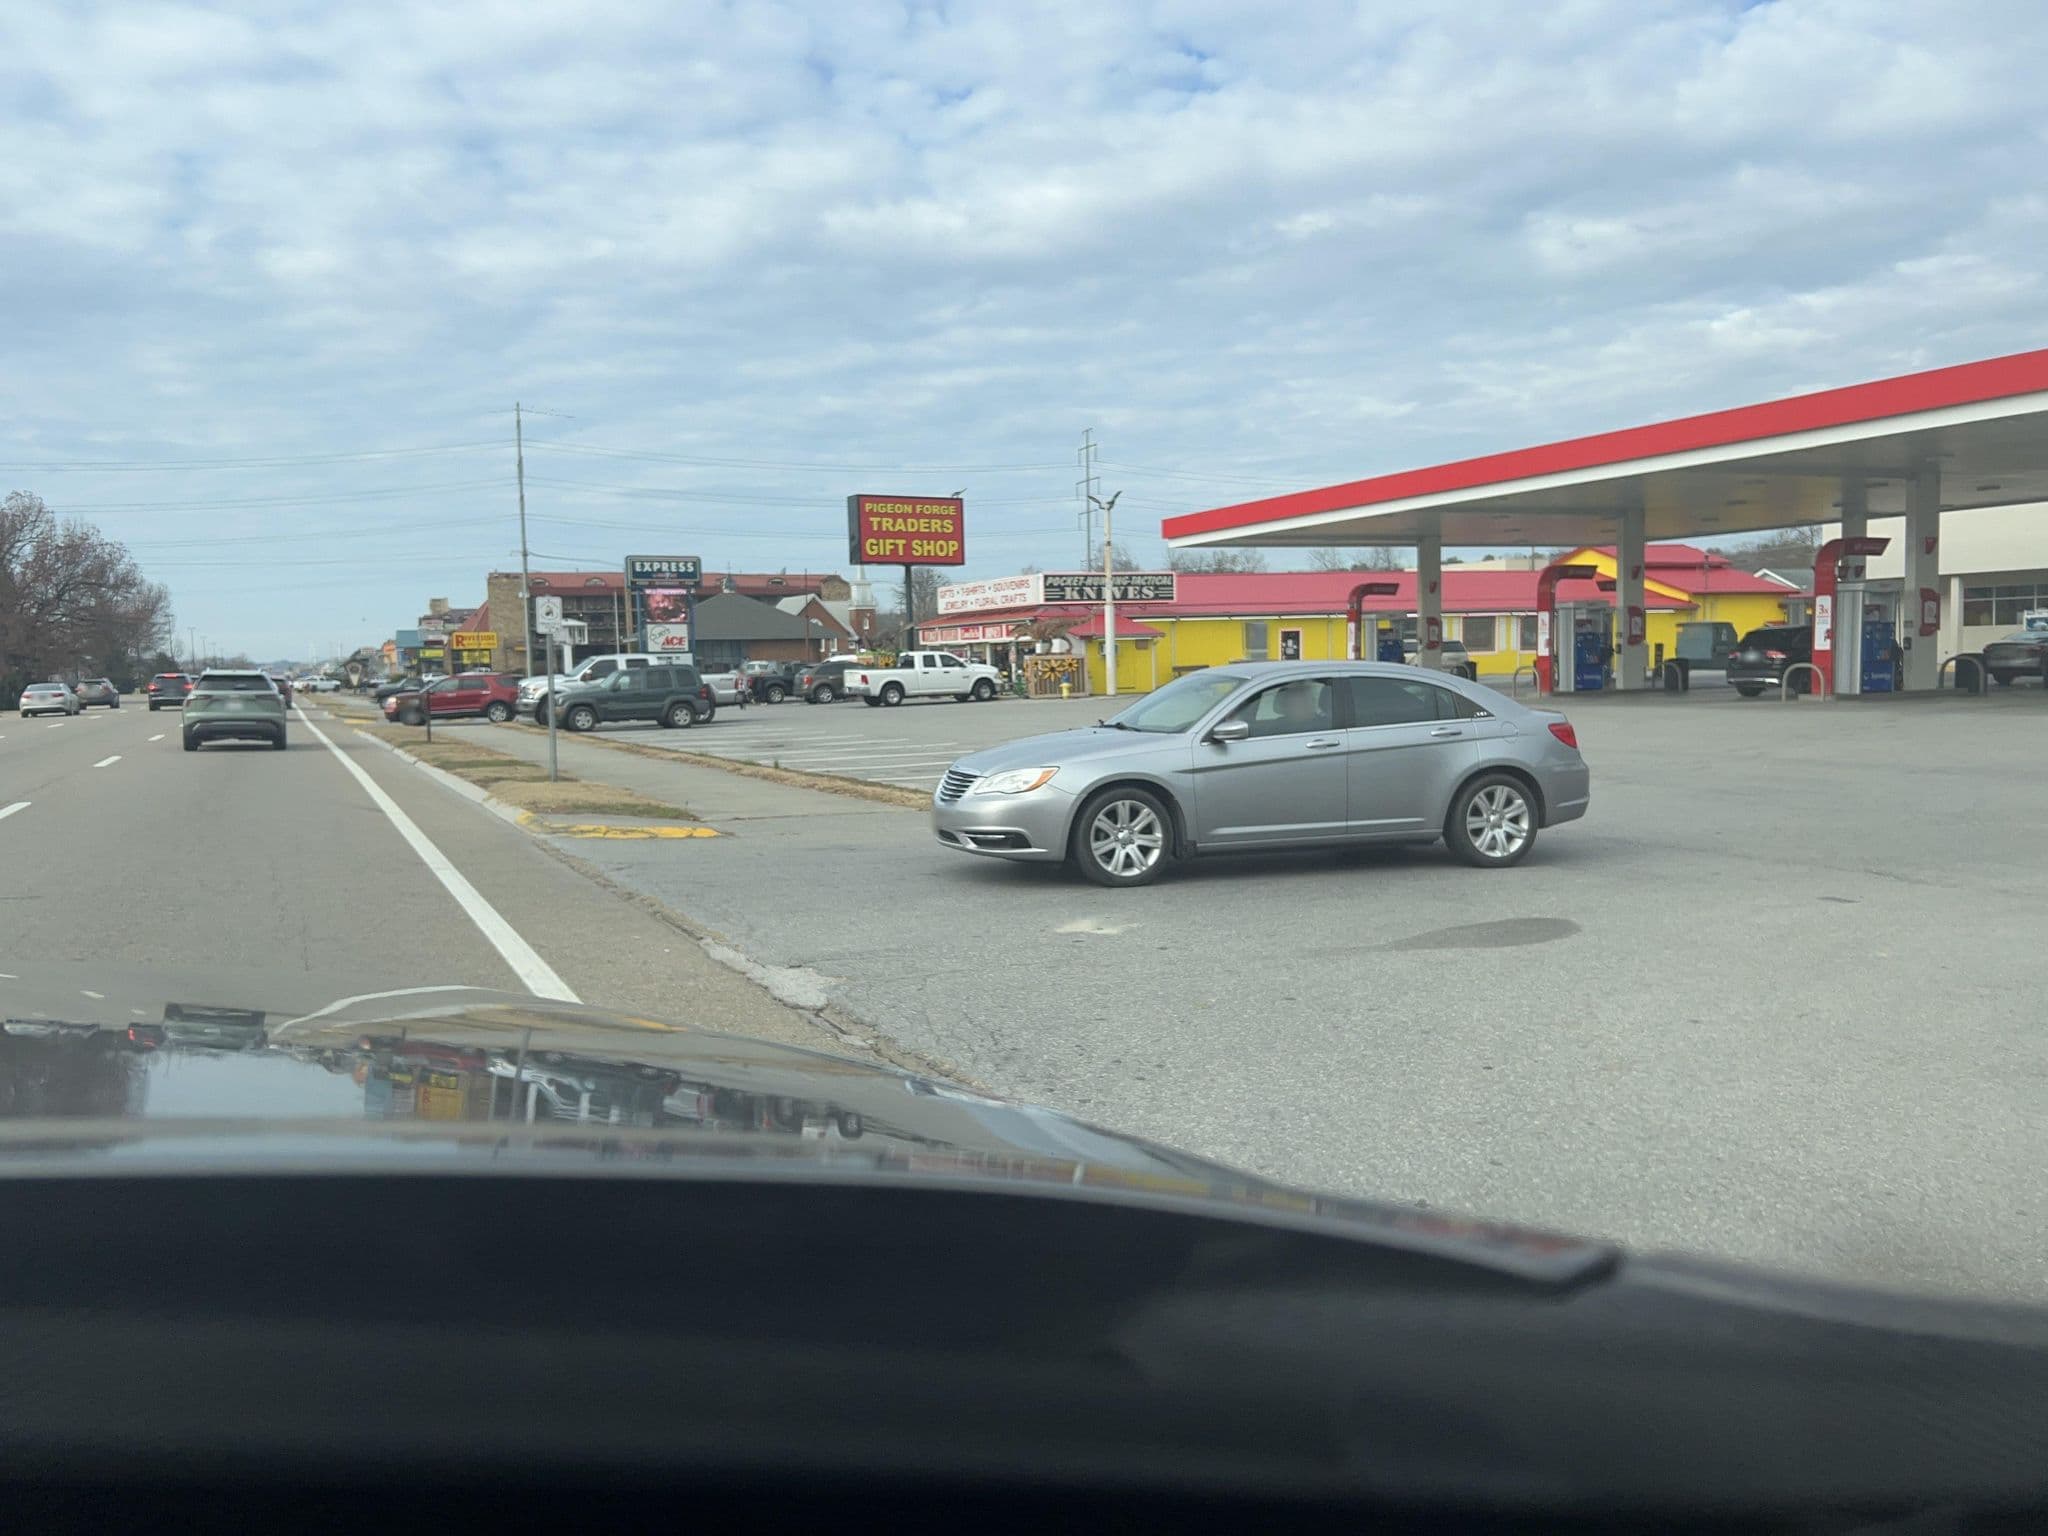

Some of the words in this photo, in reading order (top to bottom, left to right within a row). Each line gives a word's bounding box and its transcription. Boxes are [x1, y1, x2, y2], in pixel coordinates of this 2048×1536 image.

[865, 503, 913, 514] PIGEON
[916, 504, 957, 515] FORGE
[869, 517, 954, 533] TRADERS
[865, 538, 907, 556] GIFT
[911, 539, 959, 557] SHOP
[635, 561, 695, 572] EXPRESS
[661, 635, 686, 647] ACE
